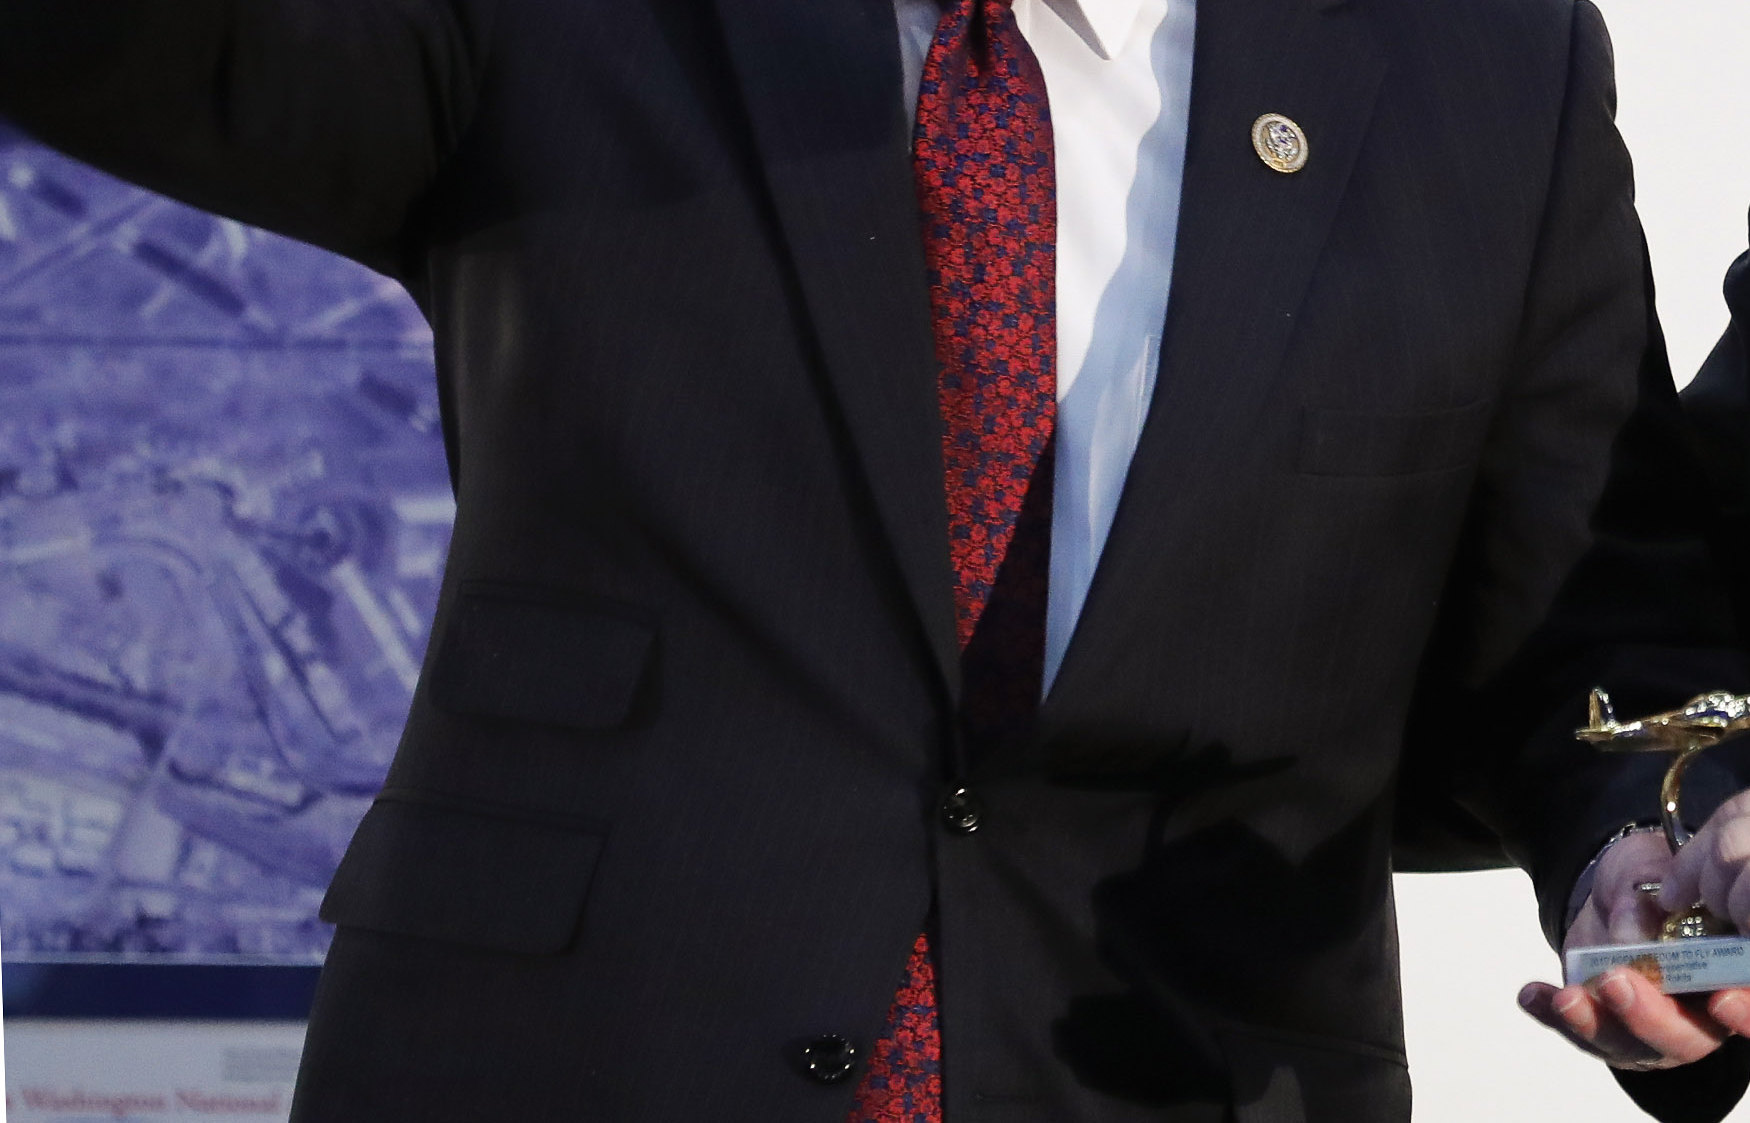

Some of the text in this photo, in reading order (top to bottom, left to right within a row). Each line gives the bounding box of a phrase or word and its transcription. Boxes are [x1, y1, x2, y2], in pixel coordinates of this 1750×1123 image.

[1681, 949, 1693, 960] TO
[1694, 948, 1710, 959] FLY
[1711, 945, 1745, 958] AWARD
